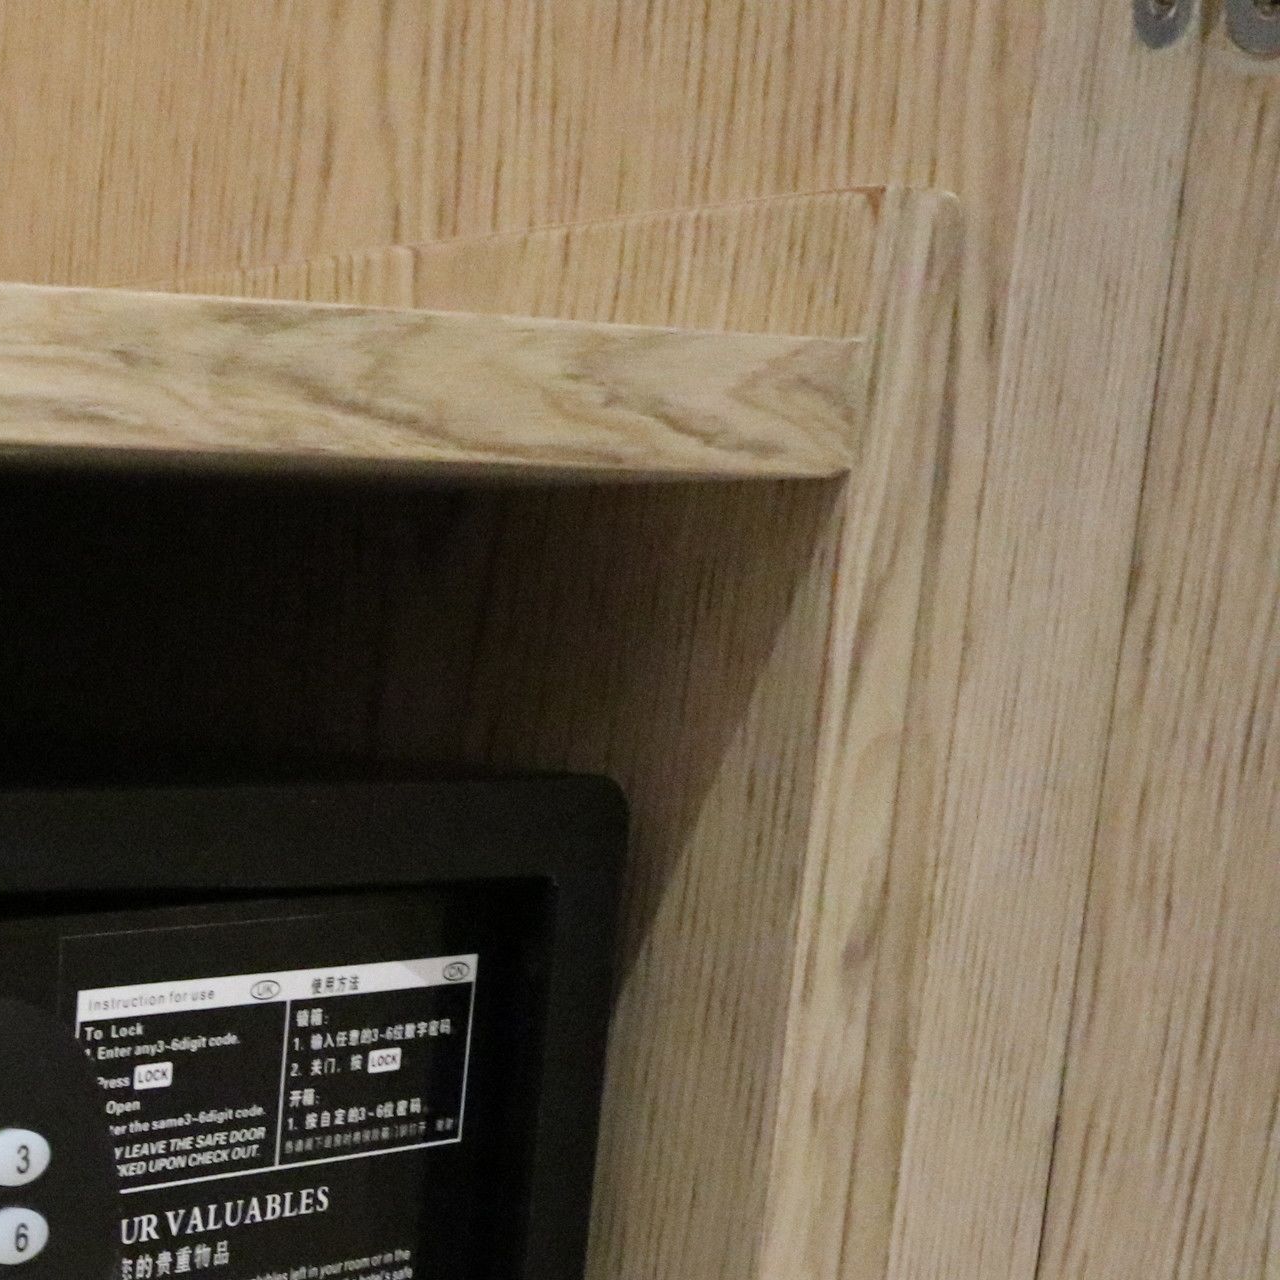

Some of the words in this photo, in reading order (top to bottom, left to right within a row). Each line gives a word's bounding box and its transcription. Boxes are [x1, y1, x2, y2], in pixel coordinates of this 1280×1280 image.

[256, 981, 275, 996] UK
[311, 975, 360, 996] 使用方法
[87, 992, 165, 1012] Instruction
[169, 989, 187, 1002] for
[191, 986, 215, 1002] use
[85, 1027, 103, 1041] To
[111, 1023, 143, 1038] Lock
[97, 1046, 132, 1060] Enter
[208, 1033, 240, 1047] code.
[293, 1037, 304, 1051] 1.
[290, 1063, 301, 1077] 2.
[351, 1054, 362, 1070] 按
[371, 1054, 397, 1068] LOCK
[137, 1071, 168, 1084] LOCK
[106, 1101, 140, 1116] Open
[129, 1120, 150, 1133] the
[235, 1105, 265, 1118] code.
[287, 1117, 298, 1131] 1.
[124, 1140, 167, 1158] LEAVE
[169, 1136, 194, 1151] THE
[195, 1132, 230, 1148] SAFE
[229, 1127, 266, 1143] DOOR
[17, 1145, 31, 1174] 3
[148, 1155, 187, 1172] UPON
[188, 1149, 232, 1167] CHECK
[165, 1186, 328, 1236] VALUABLES
[15, 1223, 29, 1253] 6
[307, 1265, 318, 1278] in
[319, 1262, 343, 1279] your
[343, 1258, 371, 1271] room
[392, 1266, 413, 1280] safe
